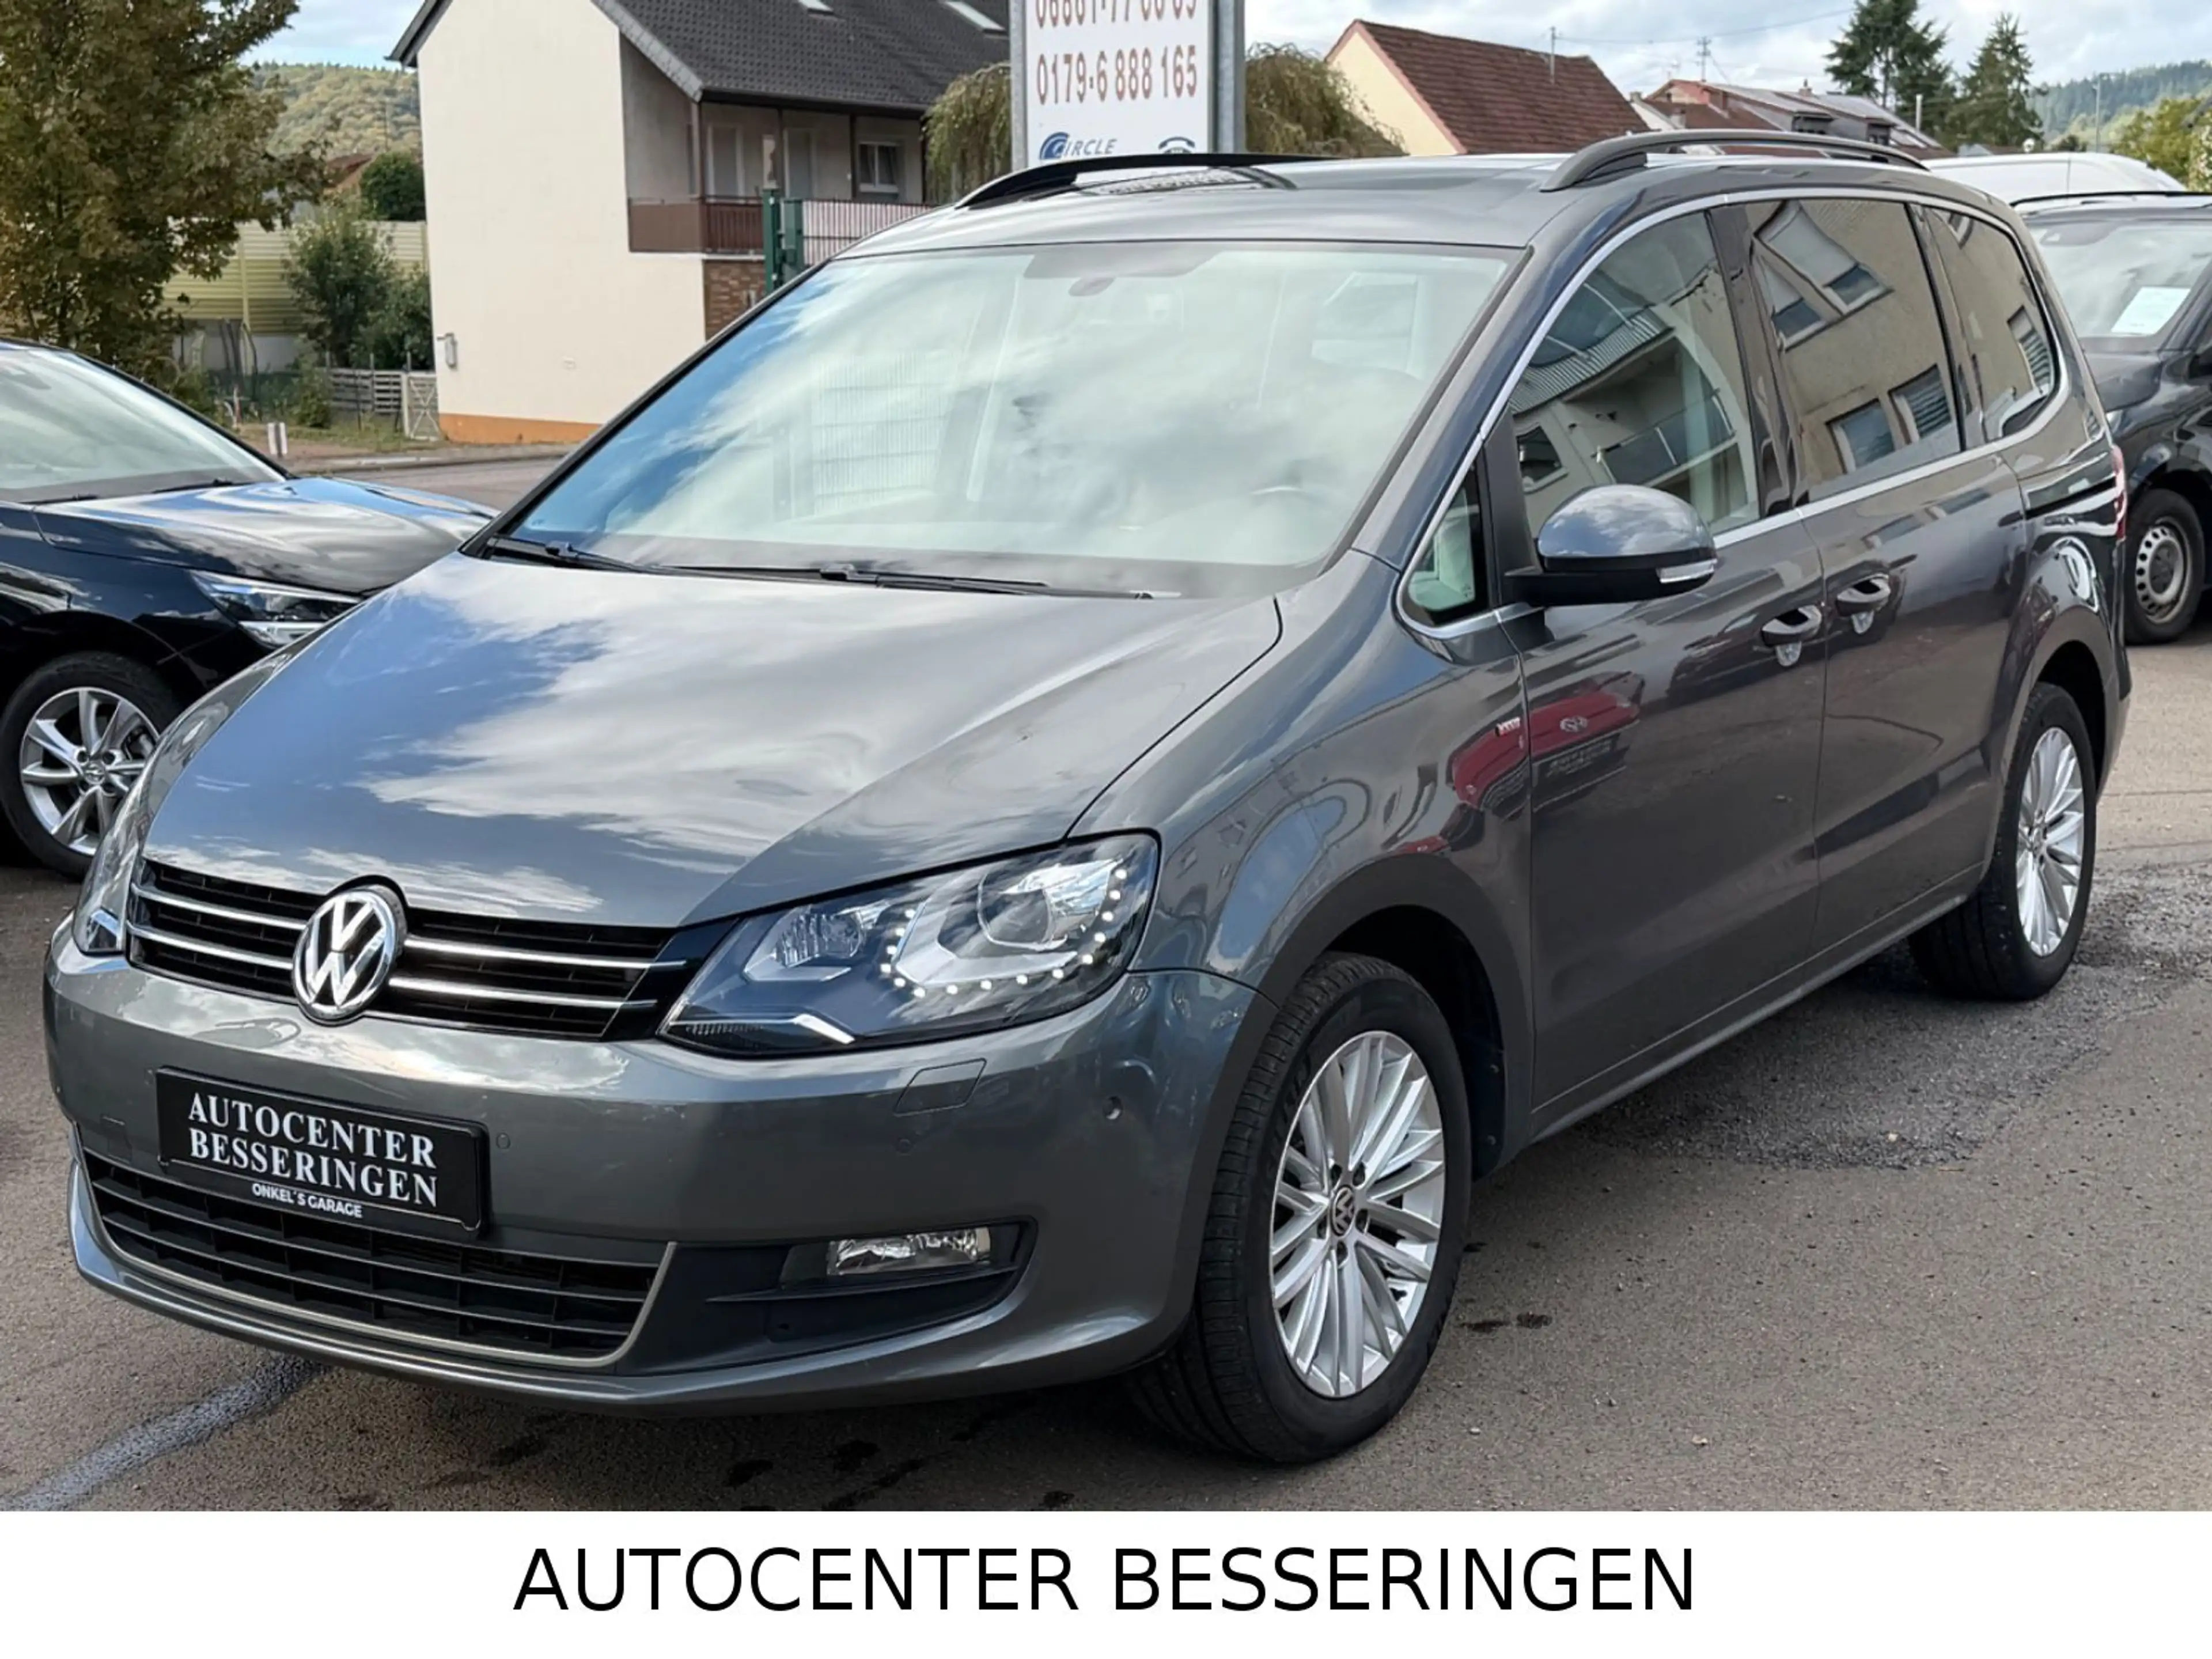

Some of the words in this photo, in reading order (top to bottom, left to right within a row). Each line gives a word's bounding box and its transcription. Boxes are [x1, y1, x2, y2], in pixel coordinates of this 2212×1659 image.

[1115, 47, 1152, 101] 888
[1161, 44, 1197, 99] 165
[188, 1092, 437, 1169] AUTOCENTER
[189, 1127, 438, 1207] BESSERINGEN
[307, 1195, 363, 1219] GARAGE
